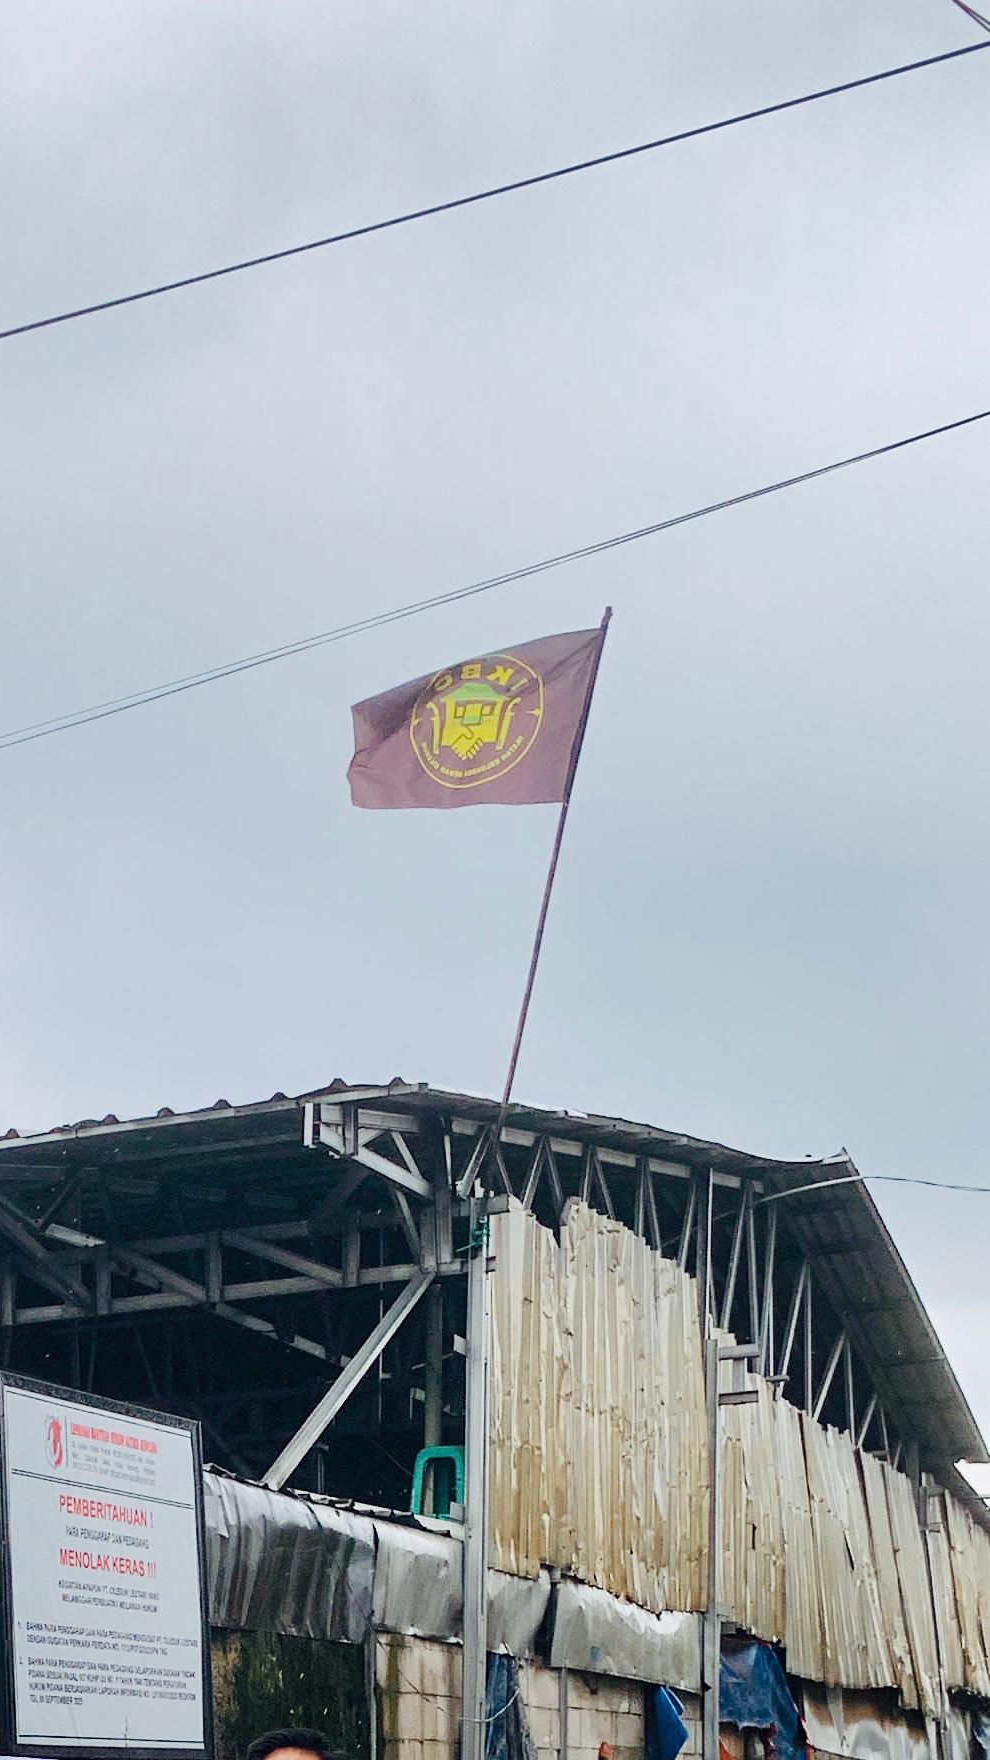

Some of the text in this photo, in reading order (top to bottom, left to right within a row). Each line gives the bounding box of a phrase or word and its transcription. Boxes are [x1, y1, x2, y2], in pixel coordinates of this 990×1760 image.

[59, 1495, 146, 1526] PEMBERITAHUAN
[60, 1548, 110, 1571] MENOLAK
[113, 1557, 144, 1576] KERAS
